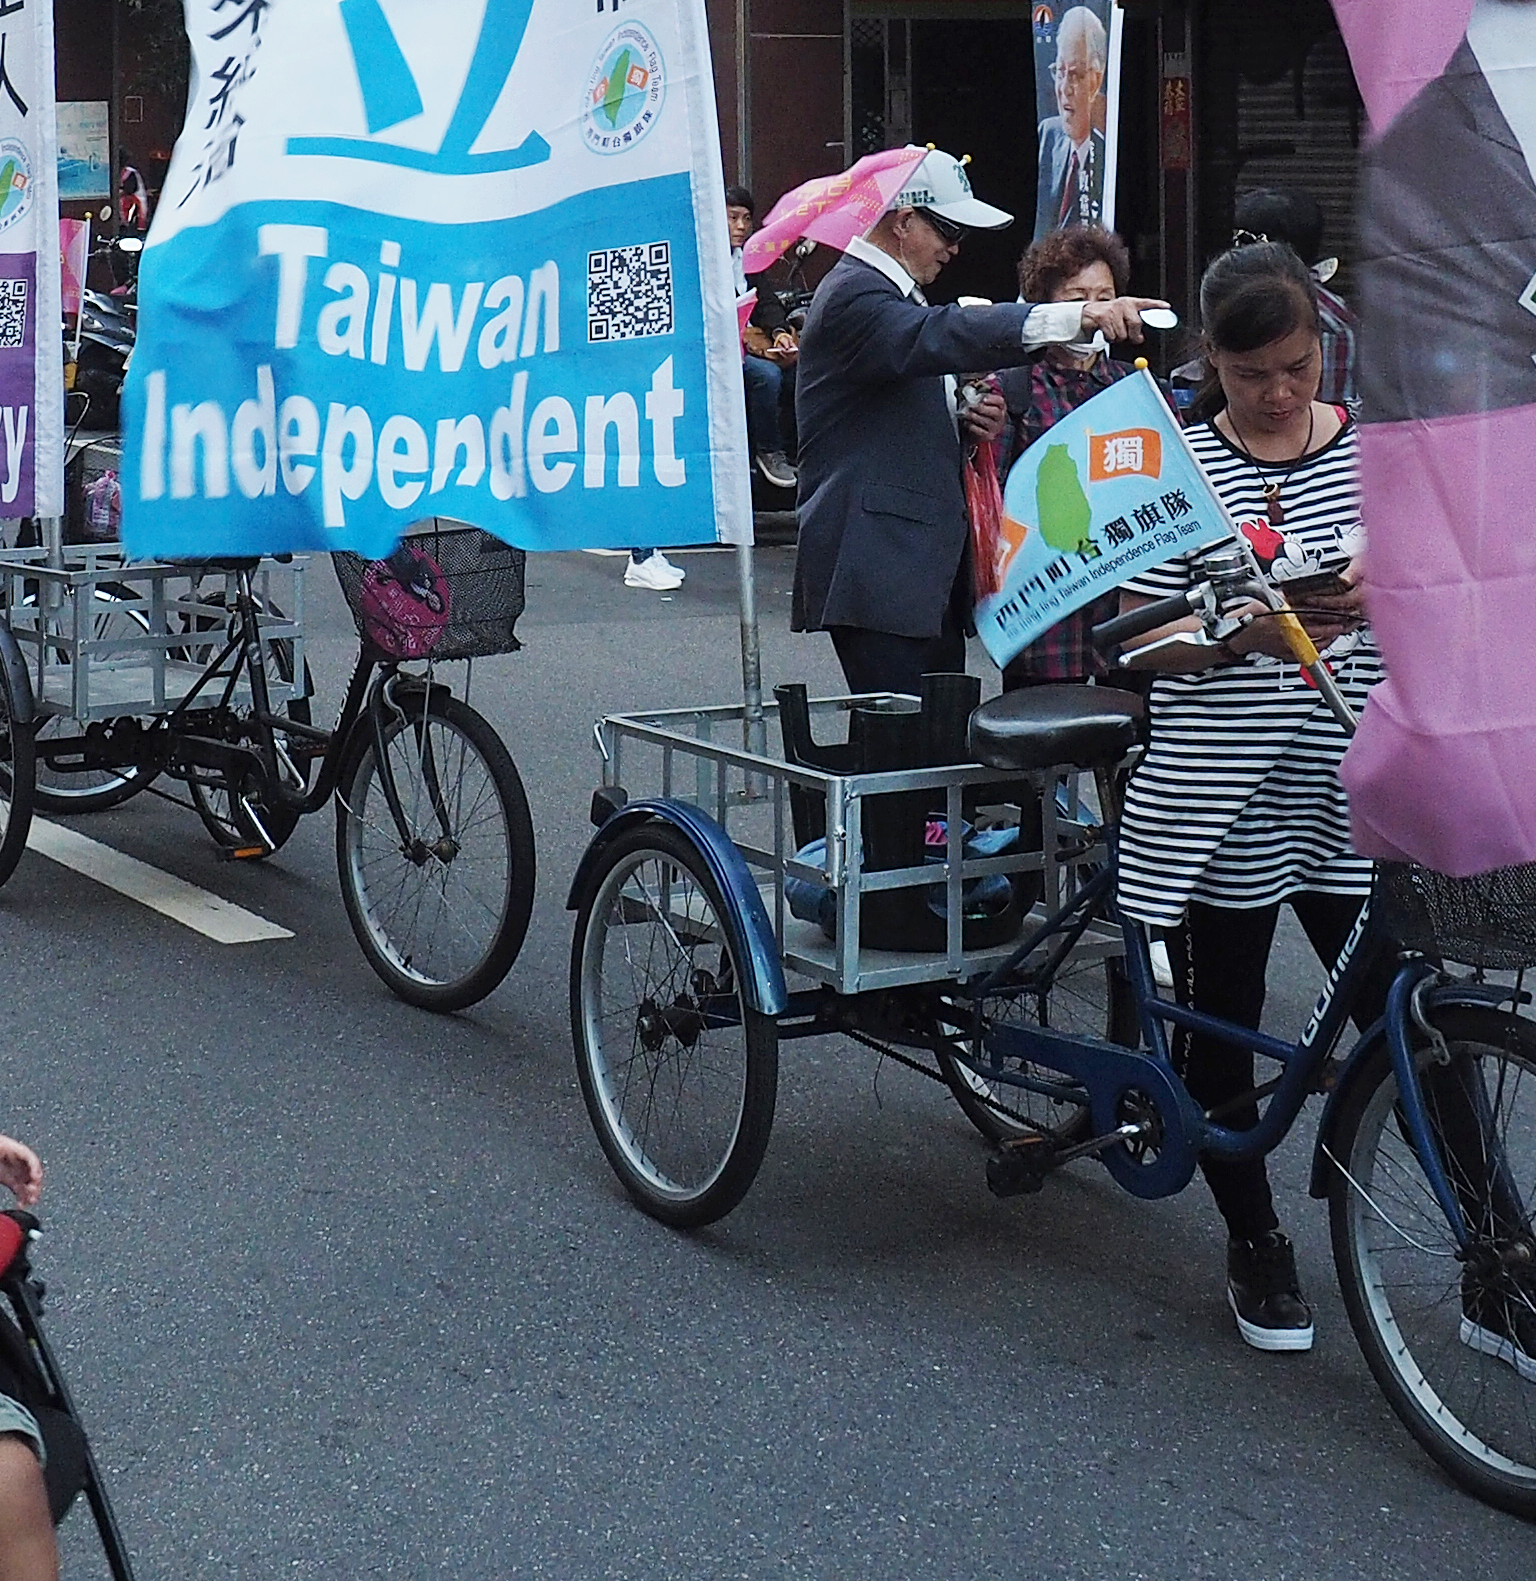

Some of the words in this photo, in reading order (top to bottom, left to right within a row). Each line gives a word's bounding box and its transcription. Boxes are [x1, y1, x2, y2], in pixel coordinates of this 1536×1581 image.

[257, 222, 561, 374] Taiwan
[140, 355, 689, 528] Independent
[1104, 436, 1143, 473] 獨
[994, 488, 1194, 631] 西門町台獨旗隊
[1090, 538, 1156, 582] Independence
[1153, 528, 1177, 552] Flag
[1176, 519, 1202, 538] Team
